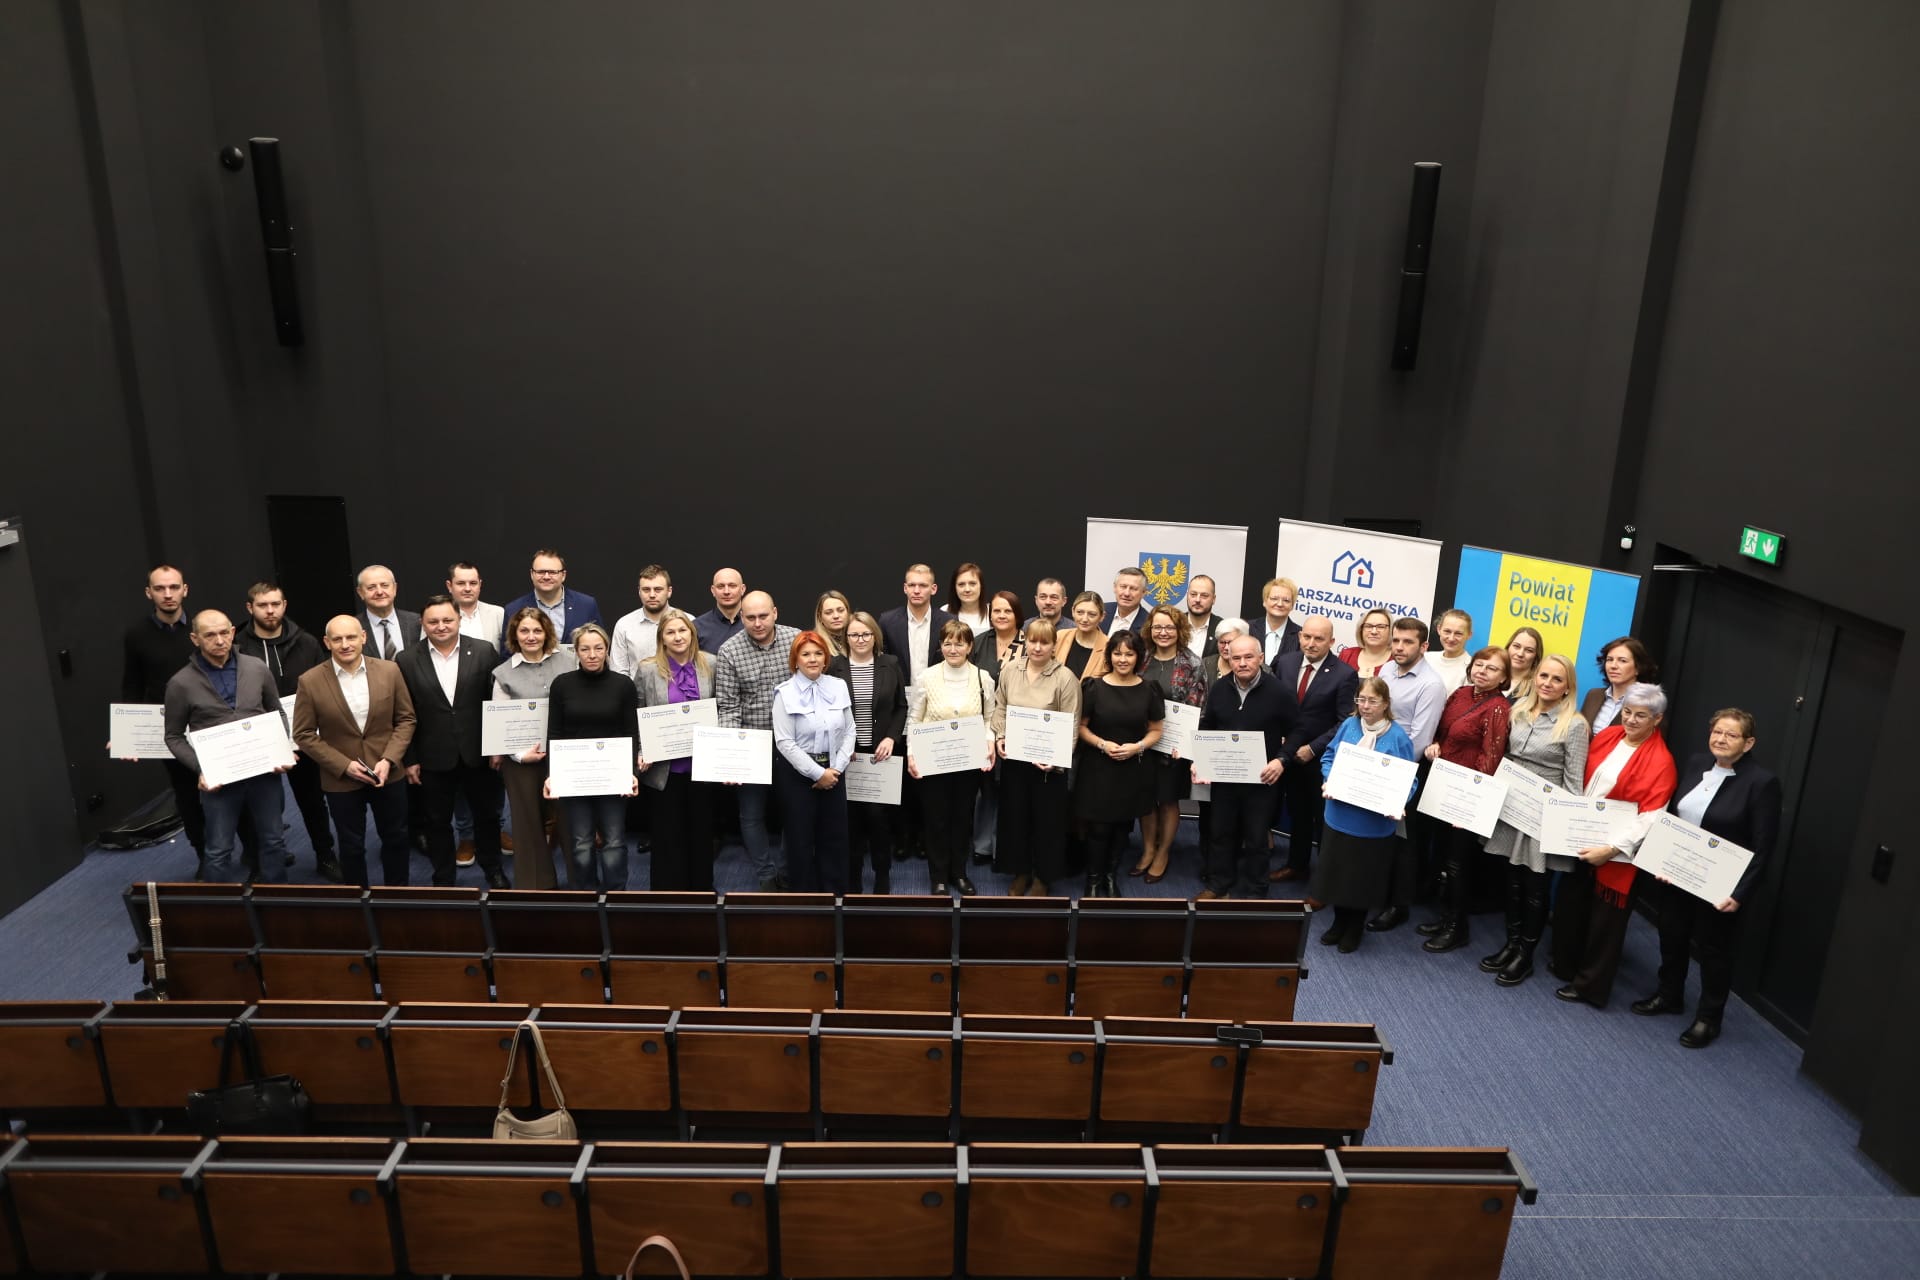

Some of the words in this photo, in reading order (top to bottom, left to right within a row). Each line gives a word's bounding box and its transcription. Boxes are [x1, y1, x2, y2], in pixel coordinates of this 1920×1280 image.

[1509, 571, 1575, 603] Powiat
[1295, 600, 1353, 621] icjatywa
[1296, 587, 1419, 618] ARSZAŁKOWSKA
[1509, 597, 1570, 627] Oleski
